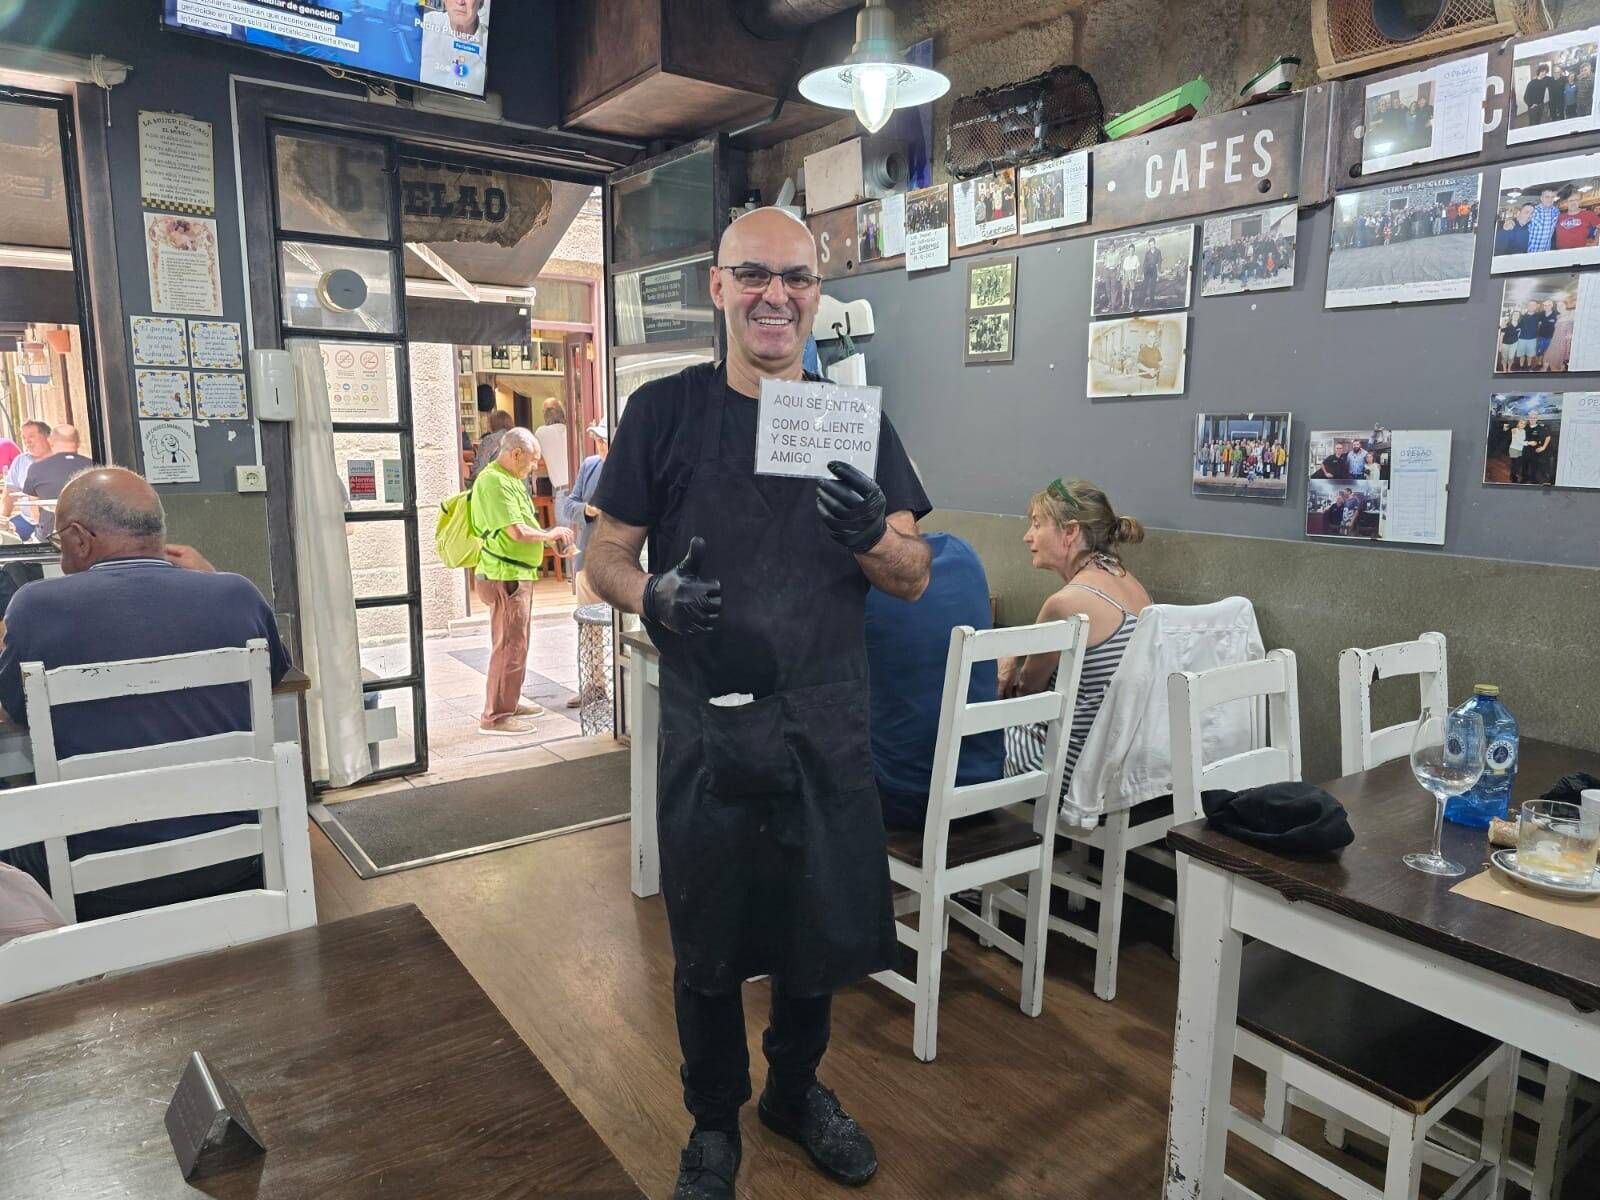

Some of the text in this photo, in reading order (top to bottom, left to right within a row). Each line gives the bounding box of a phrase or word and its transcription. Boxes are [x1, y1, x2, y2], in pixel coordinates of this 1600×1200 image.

[287, 1, 298, 10] de
[298, 5, 341, 21] genocidio
[1145, 129, 1275, 199] CAFES
[774, 395, 867, 413] AQUI SE ENTRA
[771, 417, 865, 434] COMO CLIENTE
[771, 433, 872, 452] Y SE SALE COMO
[770, 450, 811, 464] AMIGO
